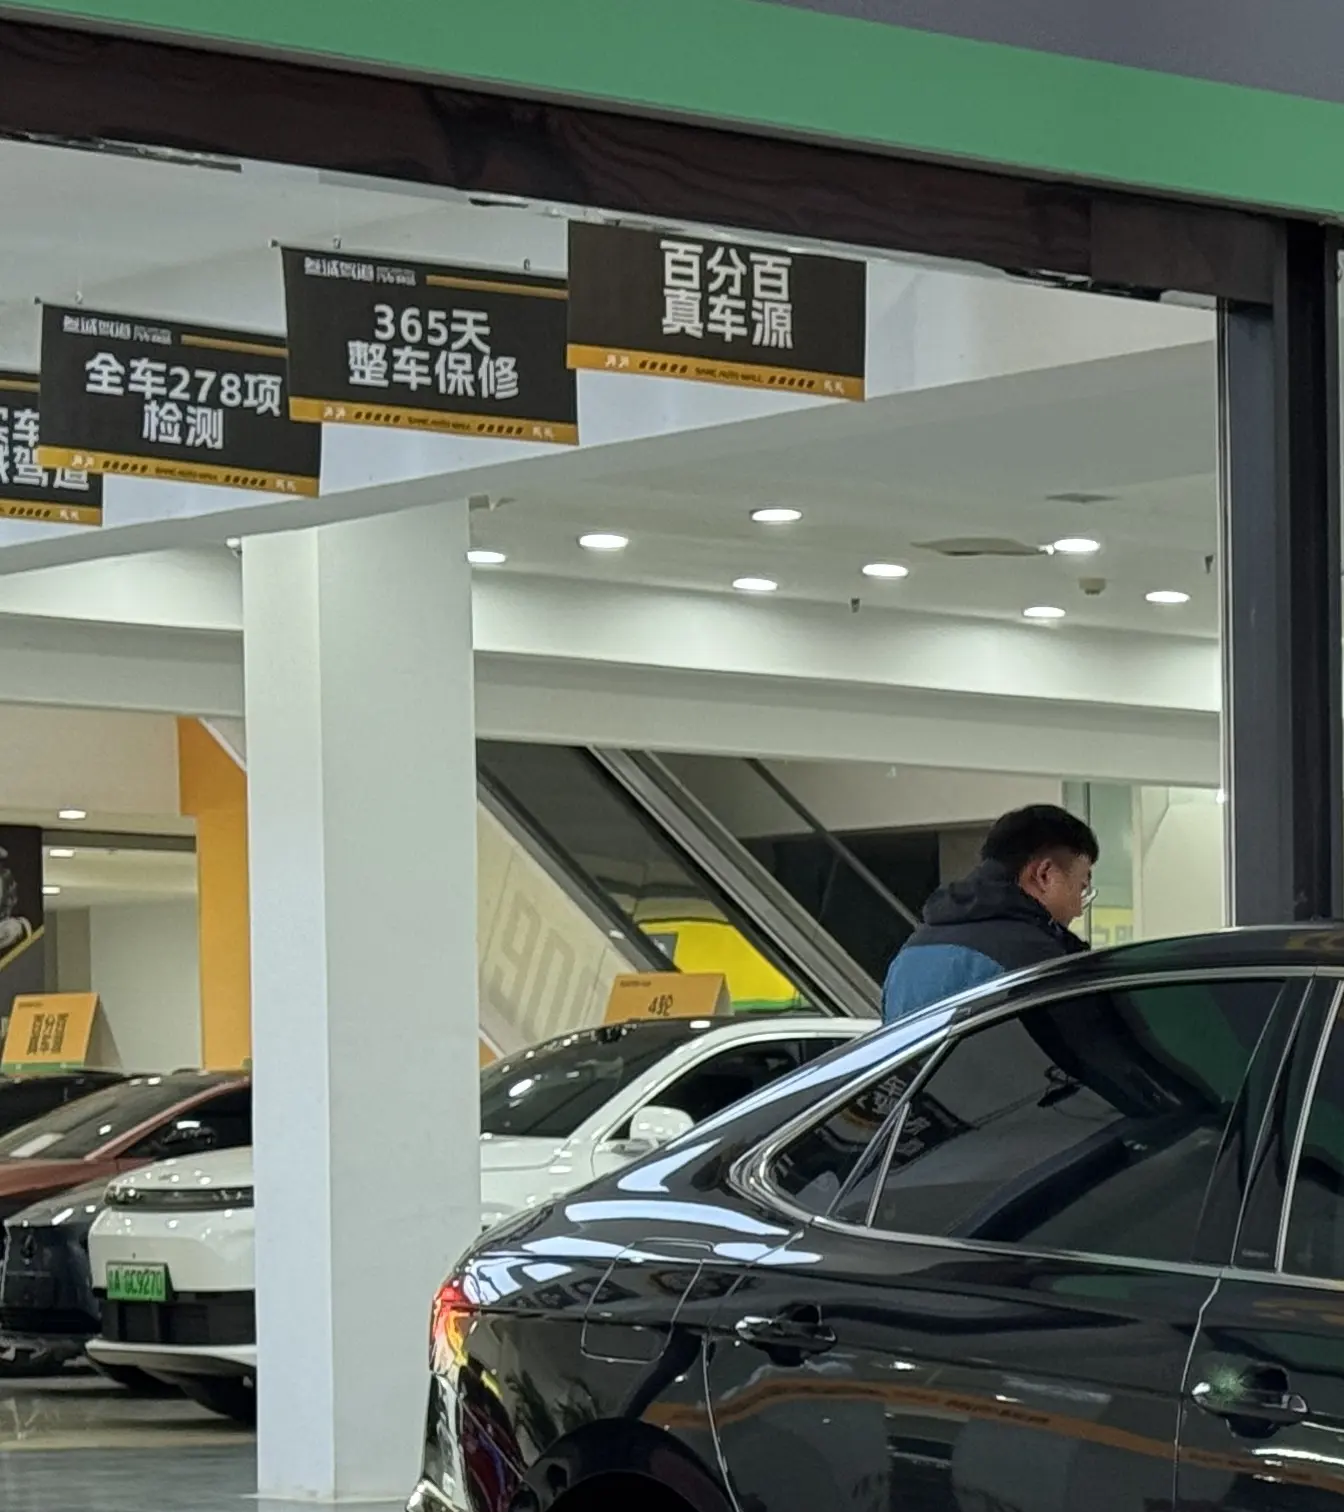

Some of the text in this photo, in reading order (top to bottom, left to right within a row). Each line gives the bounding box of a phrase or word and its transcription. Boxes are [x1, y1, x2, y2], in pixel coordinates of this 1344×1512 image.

[660, 239, 793, 301] 百分百
[374, 304, 491, 354] 365天
[661, 288, 794, 349] 真车源
[85, 352, 283, 417] 全车278项
[348, 340, 519, 400] 整车保修
[142, 401, 224, 450] 检测
